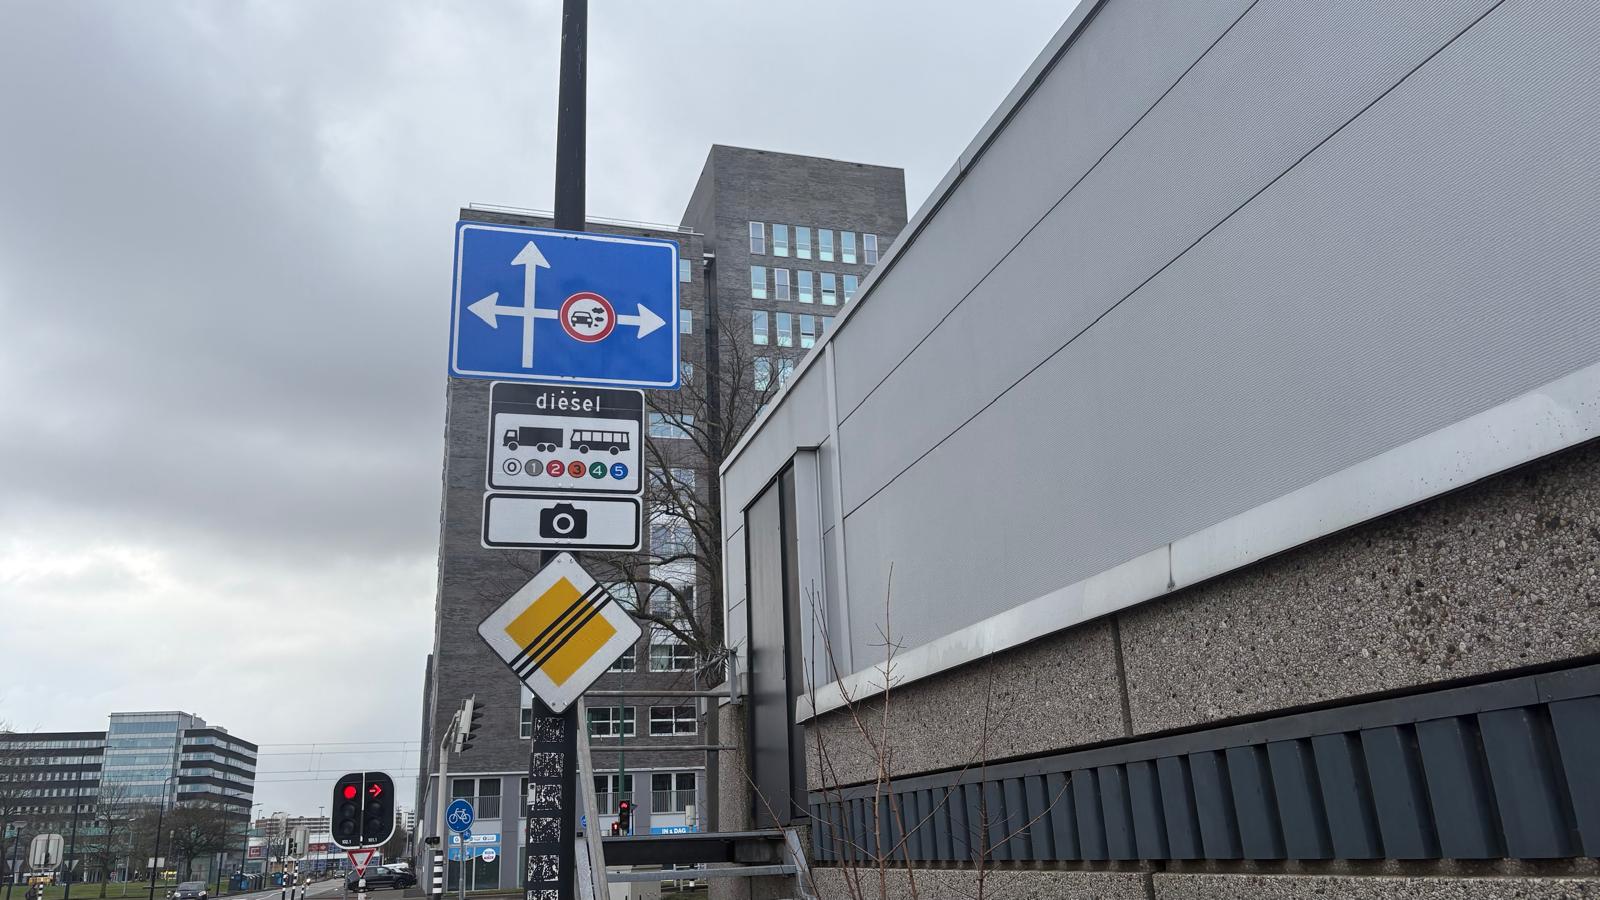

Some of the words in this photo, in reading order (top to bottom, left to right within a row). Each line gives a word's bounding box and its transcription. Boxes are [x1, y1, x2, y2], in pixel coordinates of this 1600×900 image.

[536, 392, 600, 412] diesel
[507, 461, 517, 472] 0
[551, 464, 560, 474] 2
[573, 464, 581, 475] 3
[592, 465, 602, 475] 4
[614, 466, 624, 477] 5
